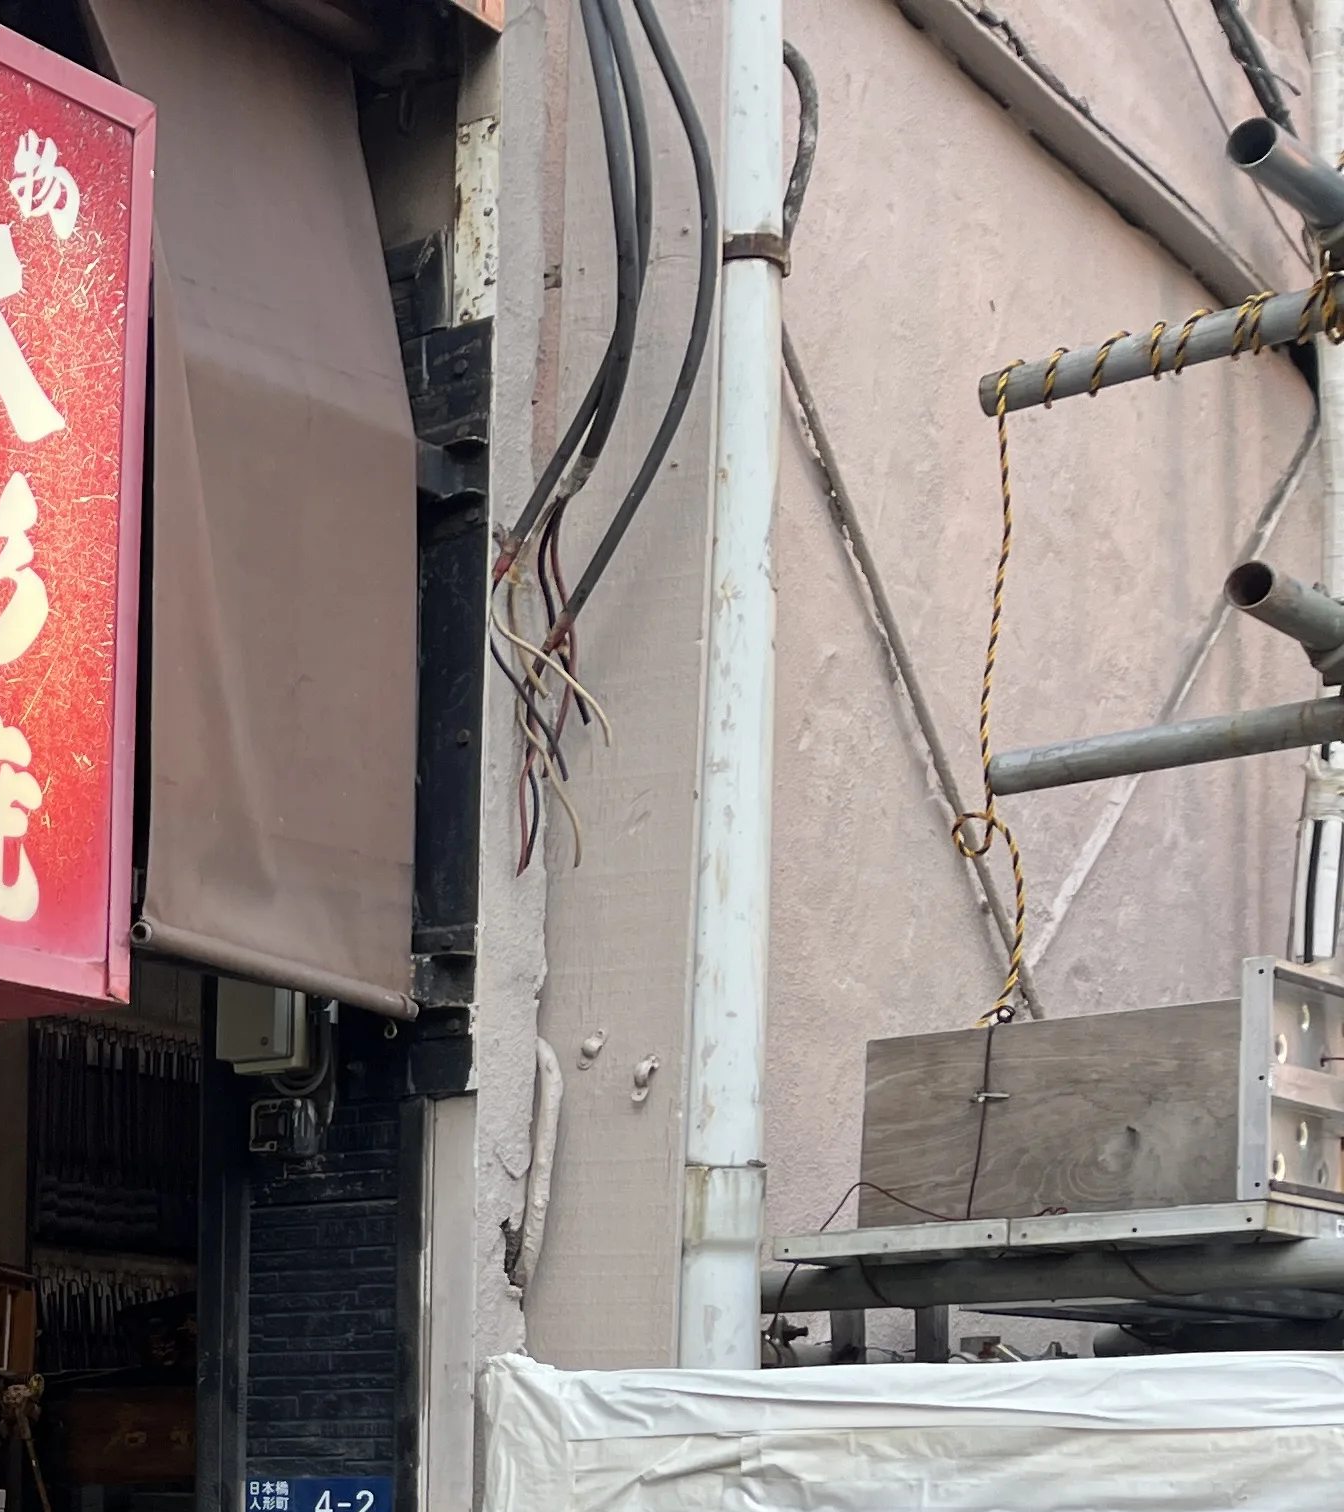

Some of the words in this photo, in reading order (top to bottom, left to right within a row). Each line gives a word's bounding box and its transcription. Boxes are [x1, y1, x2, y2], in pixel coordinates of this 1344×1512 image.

[250, 1481, 289, 1496] 日本橋
[250, 1496, 290, 1511] 人形町
